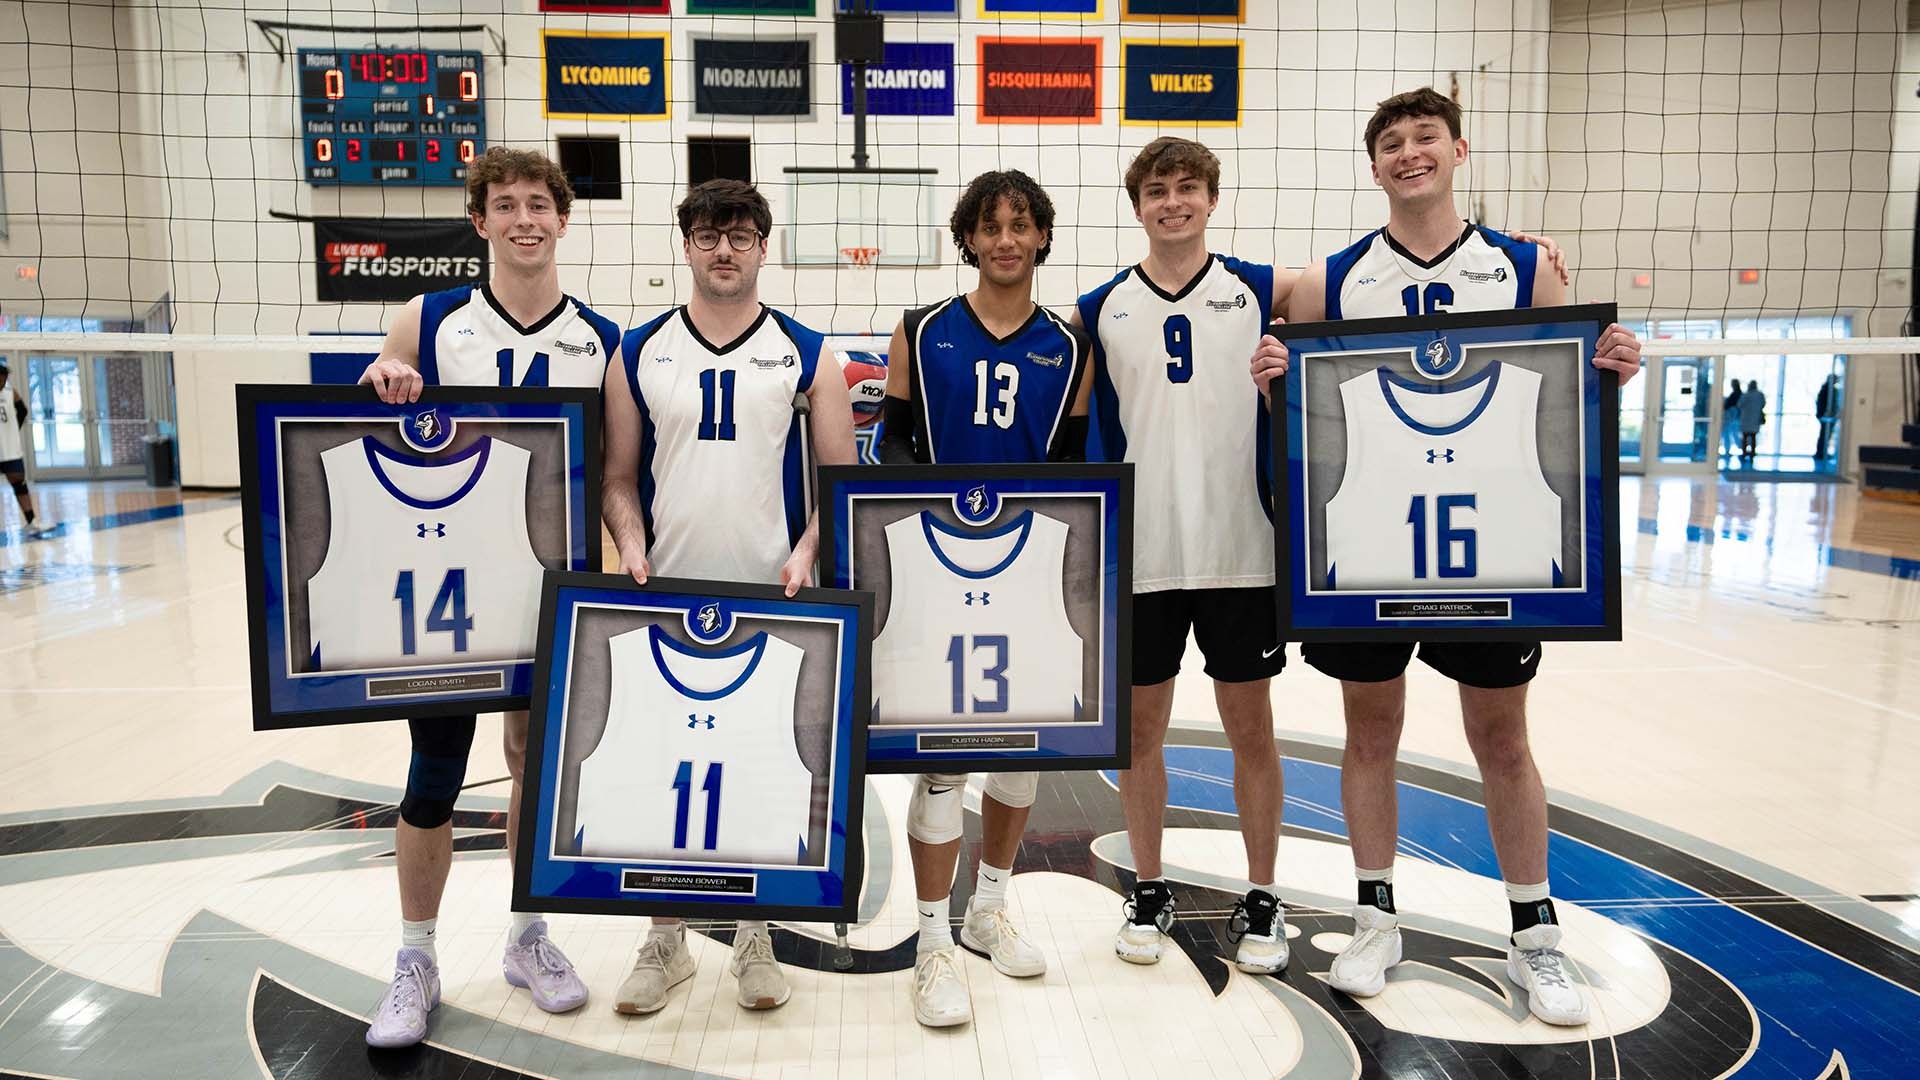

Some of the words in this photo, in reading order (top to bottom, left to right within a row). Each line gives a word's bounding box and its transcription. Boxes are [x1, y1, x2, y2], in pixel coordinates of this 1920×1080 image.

[306, 53, 336, 67] Home
[351, 53, 428, 83] 40:00
[325, 69, 345, 100] 0
[460, 71, 478, 101] 0
[560, 64, 651, 86] LYCOMING
[702, 67, 801, 89] MORAVIAN
[851, 68, 946, 89] CRANTON
[987, 71, 1092, 89] SUSQUEHANNA
[1150, 73, 1214, 93] WILKES
[373, 100, 409, 114] period
[426, 94, 434, 115] 1
[317, 138, 332, 161] 0
[347, 138, 361, 161] 2
[397, 140, 405, 161] 1
[426, 139, 440, 162] 2
[460, 139, 474, 162] 0
[381, 167, 409, 180] game
[333, 244, 356, 256] LIVE
[359, 244, 379, 256] ON
[343, 256, 481, 277] FLOSPORTS
[1163, 314, 1194, 384] 9
[697, 368, 737, 441] 11
[973, 359, 1020, 430] 13
[1405, 492, 1479, 580] 16
[391, 566, 475, 657] 14
[407, 680, 437, 688] LOGAN
[438, 678, 466, 686] SMITH
[945, 632, 1010, 715] 13
[670, 759, 726, 851] 11
[652, 875, 694, 884] BRENNAN
[695, 877, 727, 885] BOWER
